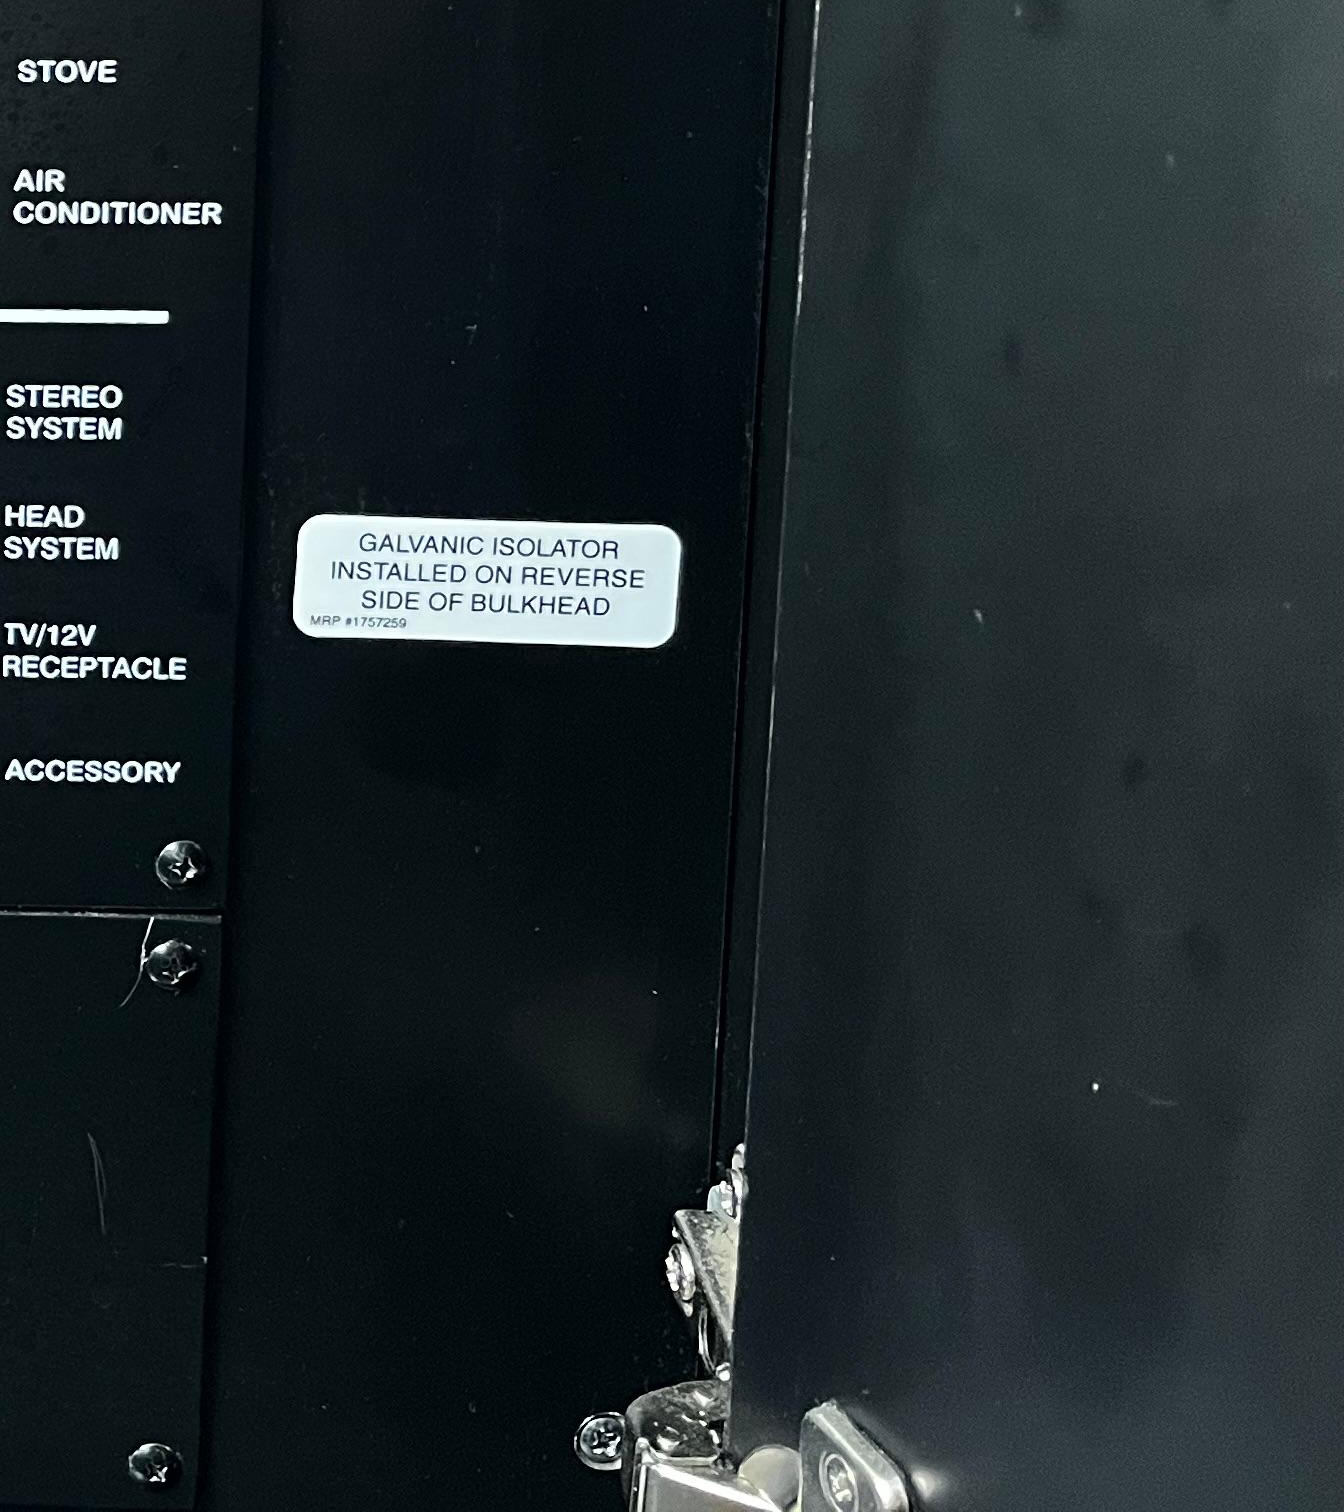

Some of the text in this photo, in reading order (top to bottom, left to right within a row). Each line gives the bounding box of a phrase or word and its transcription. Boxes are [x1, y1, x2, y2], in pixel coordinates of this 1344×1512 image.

[17, 58, 118, 84] STOVE
[13, 168, 66, 193] AIR
[12, 200, 223, 226] CONDITIONER
[5, 383, 124, 409] STEREO
[5, 415, 123, 441] SYSTEM
[4, 504, 86, 529] HEAD
[3, 535, 119, 561] SYSTEM
[359, 532, 619, 560] GALVANIC ISOLATOR
[331, 561, 645, 589] INSTALLED ON REVERSE
[361, 589, 610, 616] SIDE OF BULKHEAD
[310, 614, 407, 629] MRP #1757259
[3, 622, 97, 648] TV/12V
[2, 654, 188, 681] RECEPTACLE
[4, 758, 182, 784] ACCESSORY
